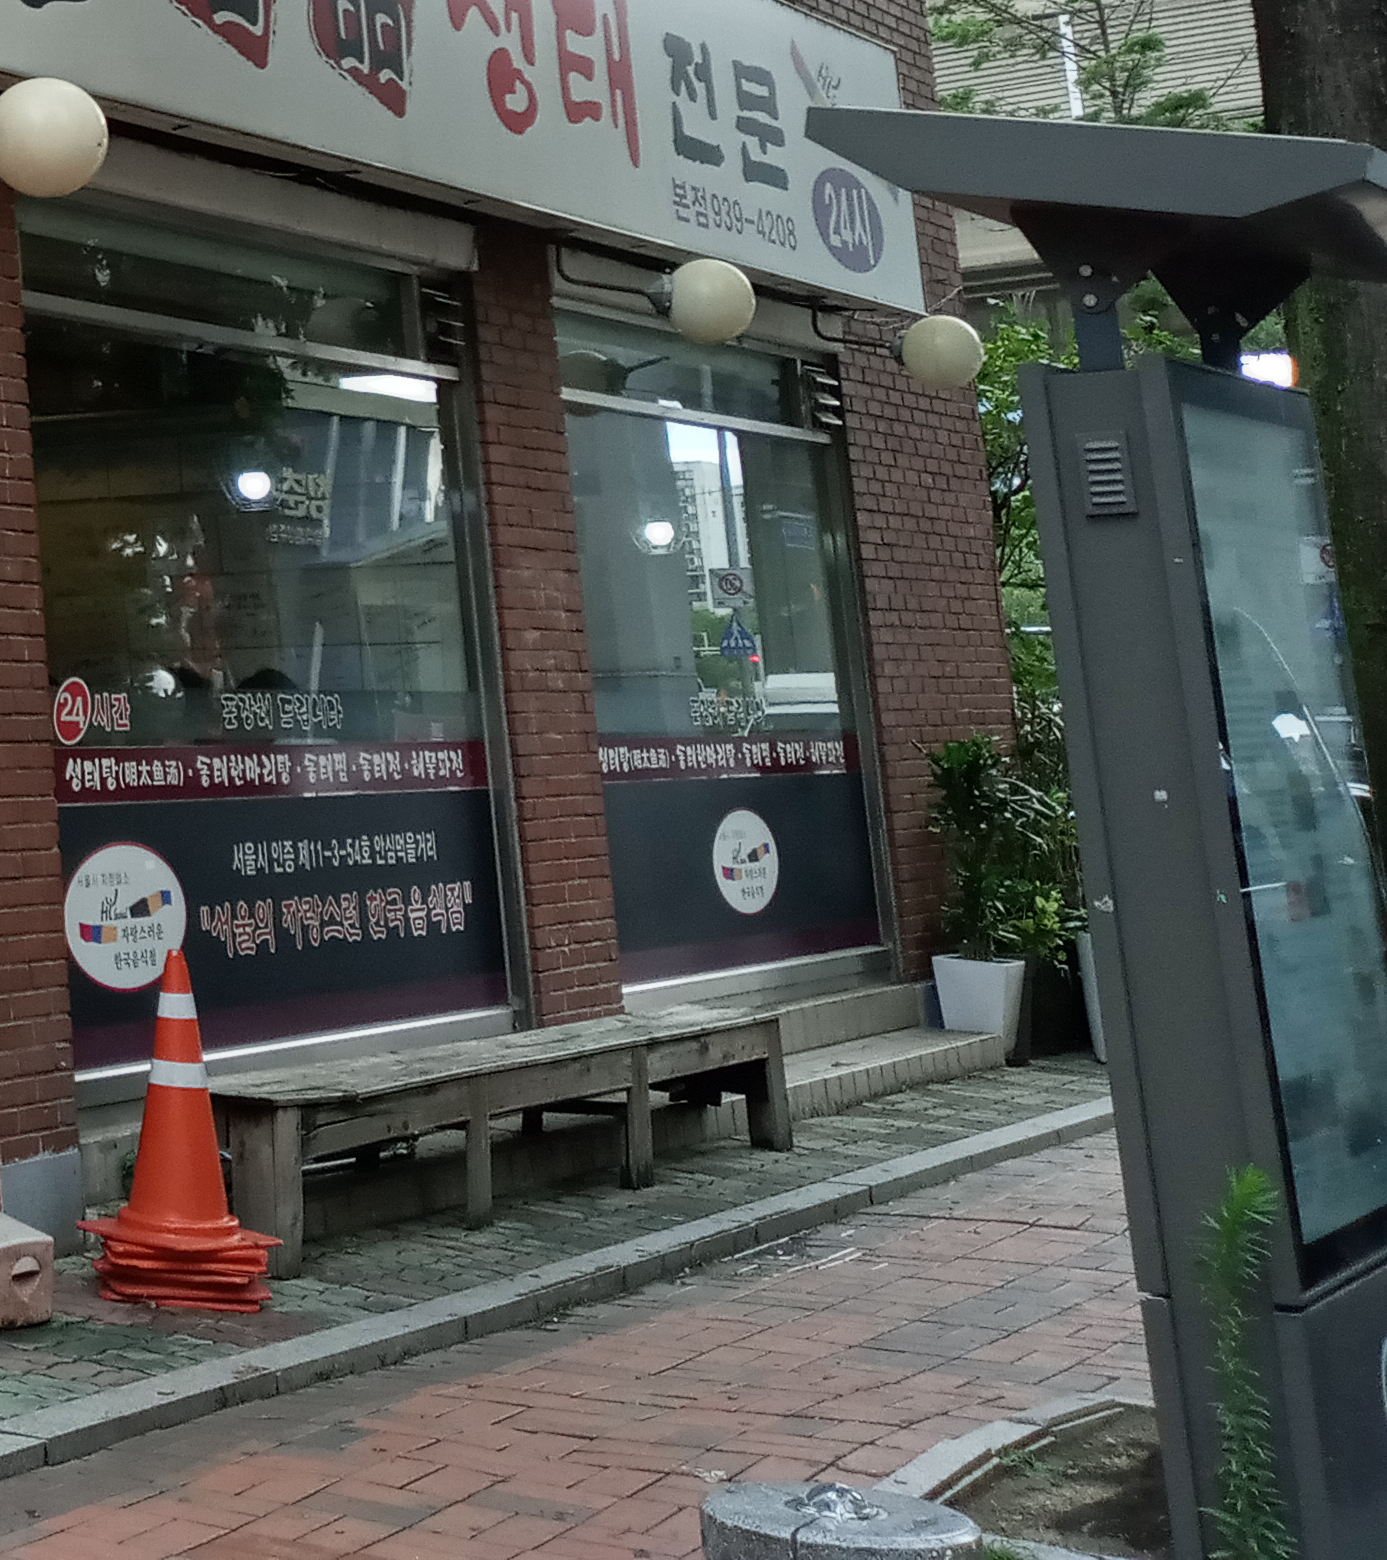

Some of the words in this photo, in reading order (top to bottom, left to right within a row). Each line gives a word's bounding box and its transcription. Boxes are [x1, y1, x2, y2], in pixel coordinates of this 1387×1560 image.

[663, 32, 789, 190] 전문
[672, 177, 709, 230] 본점
[711, 196, 797, 251] 939-4208
[825, 182, 875, 266] 24시
[221, 694, 273, 730] 포장해
[278, 694, 343, 730] 드립니다
[196, 753, 291, 788] 동태한마리탕
[232, 845, 269, 876] 서울시
[271, 842, 295, 873] 인증
[298, 836, 372, 872] 제11-3-54호
[374, 830, 437, 866] 안심먹을거리
[282, 890, 362, 949] 자랑스런
